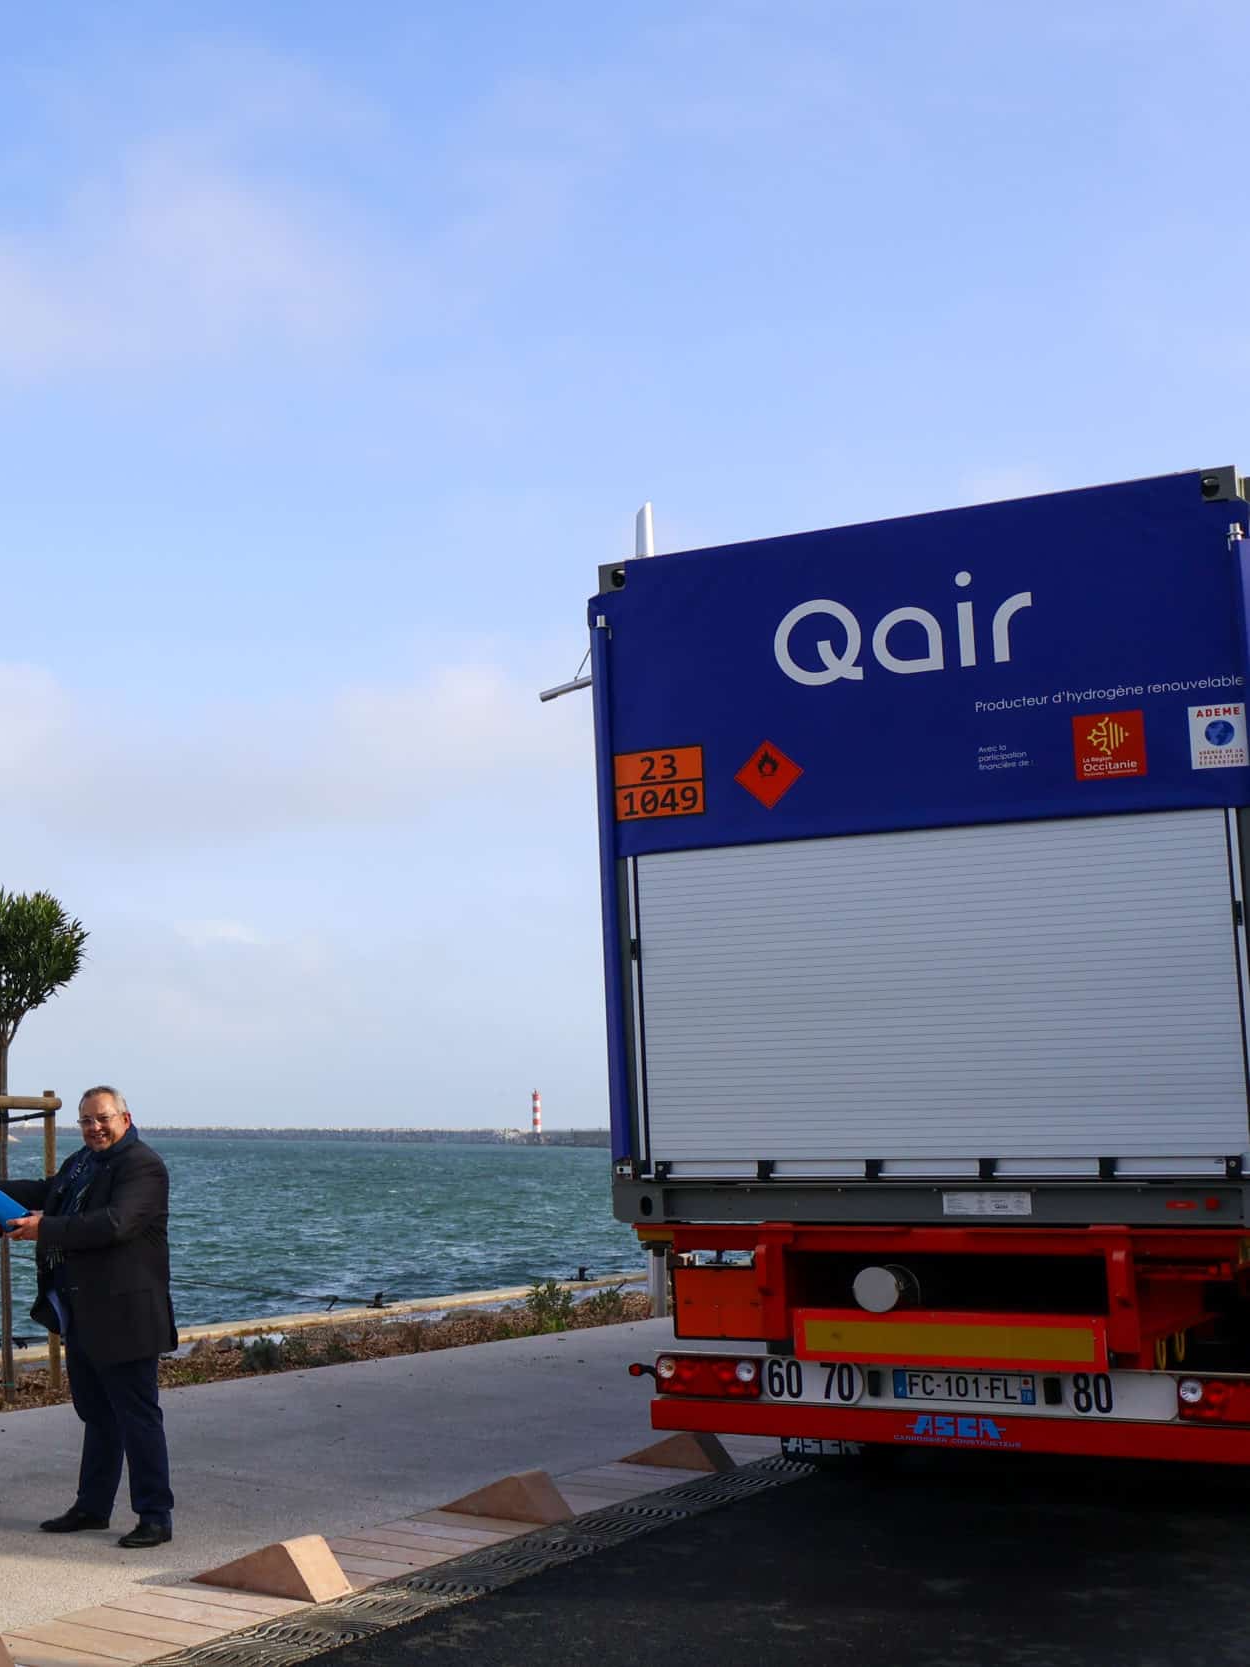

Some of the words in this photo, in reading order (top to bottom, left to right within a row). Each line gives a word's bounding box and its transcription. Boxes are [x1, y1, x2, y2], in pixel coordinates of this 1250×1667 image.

[774, 571, 1032, 686] Qair
[975, 695, 1048, 713] Producteur
[1052, 685, 1143, 703] d'hydrogène
[1147, 675, 1244, 694] renouvelable
[1196, 706, 1241, 718] ADEME
[640, 754, 678, 781] 23
[1083, 759, 1138, 772] Occitanie
[623, 786, 699, 817] 1049
[767, 1359, 803, 1398] 60
[819, 1362, 854, 1402] 70
[907, 1373, 1018, 1400] FC-101-FL
[1072, 1372, 1113, 1414] 80
[912, 1415, 1004, 1440] ASCA
